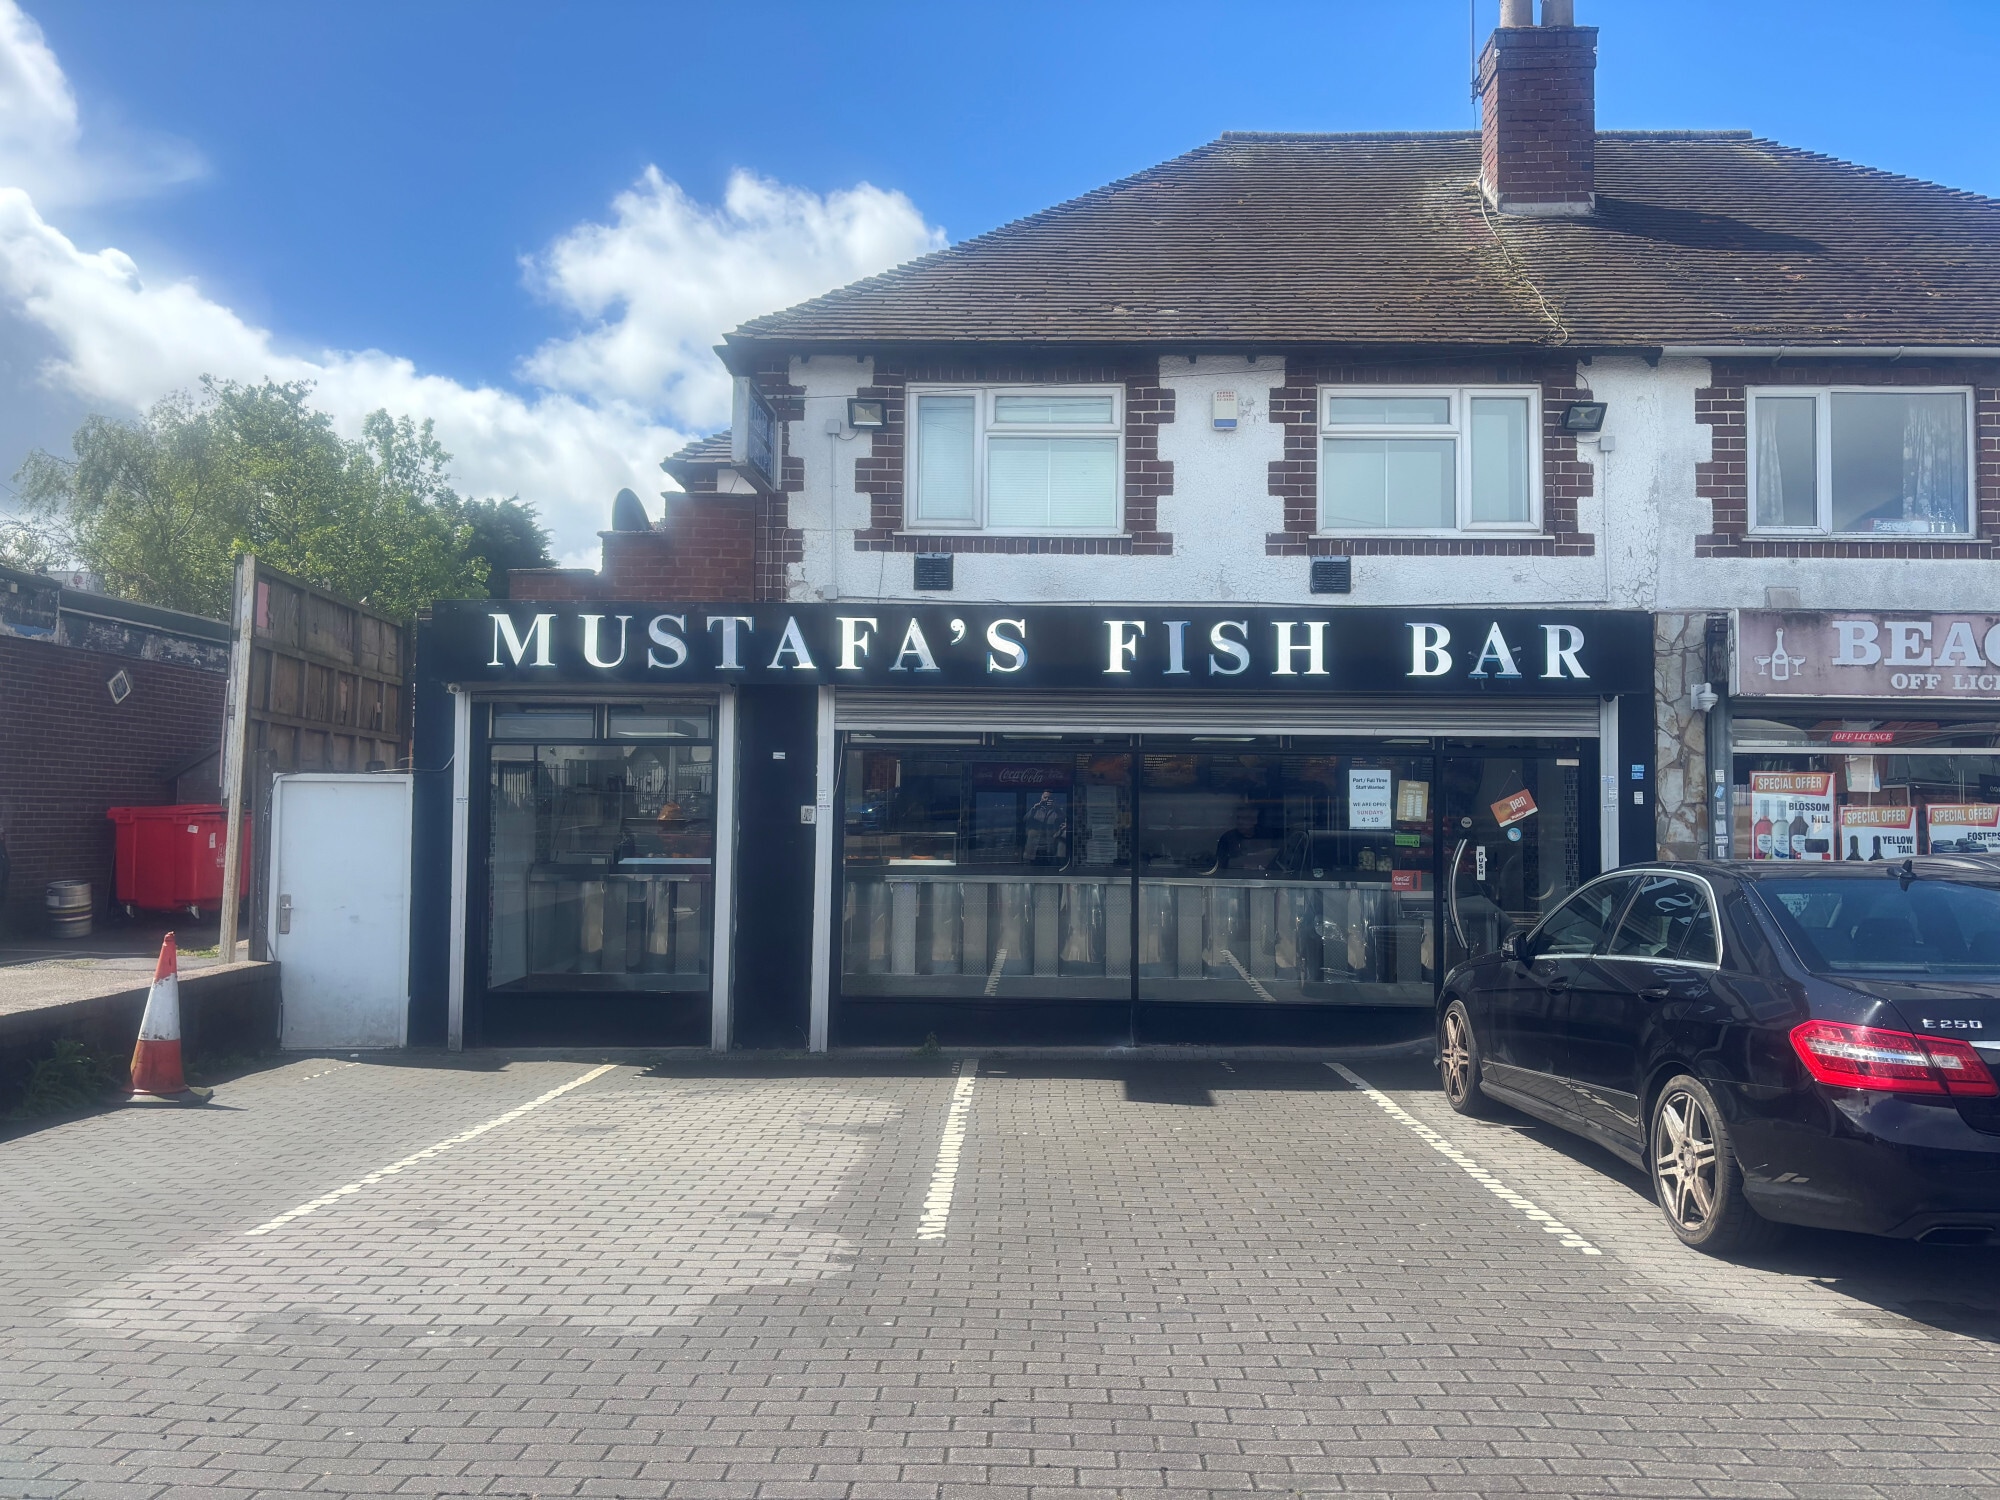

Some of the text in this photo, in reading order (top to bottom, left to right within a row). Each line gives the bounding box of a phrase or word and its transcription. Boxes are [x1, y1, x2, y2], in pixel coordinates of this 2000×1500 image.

[486, 613, 1591, 679] MUSTAFA'S FISH BAR
[1890, 673, 1942, 690] OFF
[1835, 732, 1893, 741] OFF LICENCE
[1758, 776, 1822, 790] SPECIAL OFFER
[1788, 802, 1830, 812] BLOSSOM
[1811, 815, 1831, 824] HILL
[1847, 810, 1906, 824] SPECIAL OFFER
[1934, 808, 1993, 823] SPECIAL OFFER
[1882, 836, 1914, 845] YELLOW
[1897, 845, 1914, 854] TAIL
[1922, 1018, 1983, 1029] E 250
